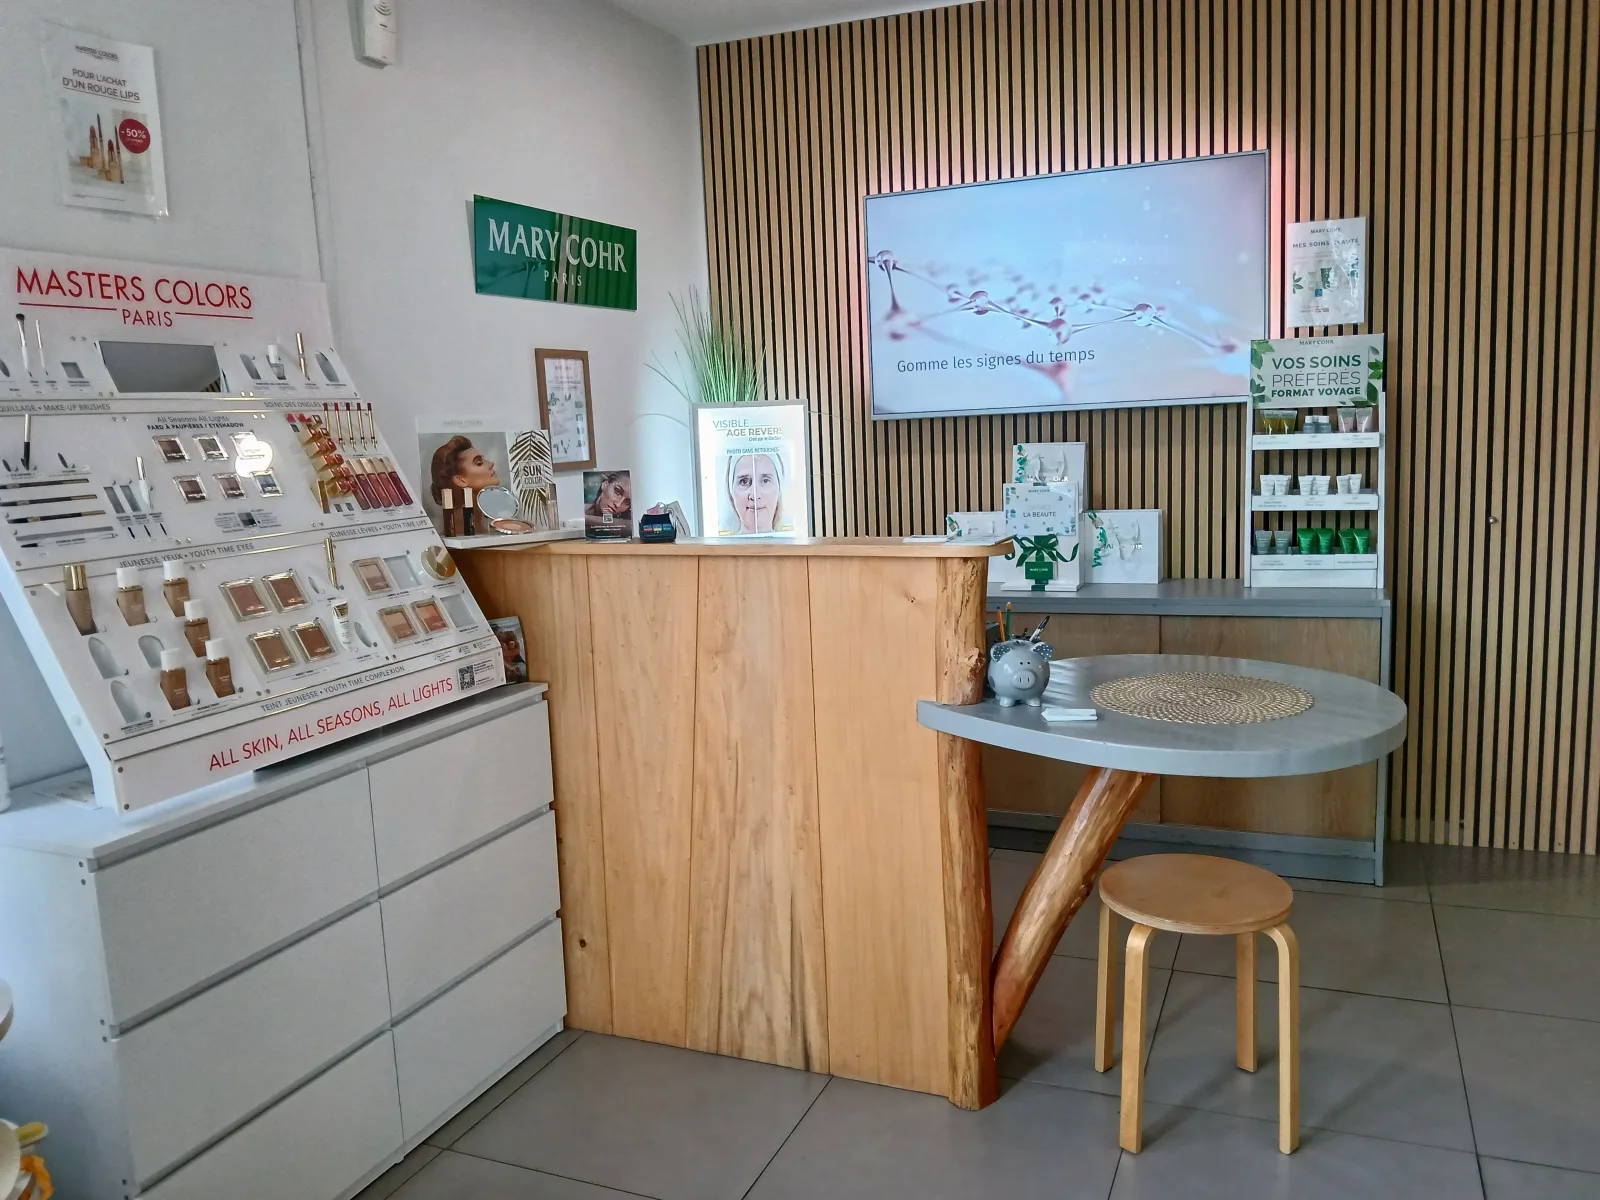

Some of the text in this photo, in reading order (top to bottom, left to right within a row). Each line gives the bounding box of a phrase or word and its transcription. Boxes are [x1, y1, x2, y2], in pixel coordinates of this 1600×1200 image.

[72, 68, 127, 87] POUR L'ACHAT
[62, 77, 140, 101] D'UN ROUGE LIPS
[488, 218, 627, 273] MARY COHR
[544, 270, 582, 286] PARIS
[16, 266, 252, 310] MASTERS COLORS
[122, 308, 173, 328] PARIS
[897, 349, 1095, 373] Gomme les signes du temps
[1272, 355, 1361, 370] VOS SOINS
[1272, 368, 1360, 387] PRÉFÉRÉS
[1272, 387, 1361, 397] FORMAT VOYAGE
[712, 419, 749, 428] VISIBLE
[726, 428, 746, 437] AGE
[523, 464, 542, 476] SUN
[329, 529, 357, 538] JEUNESSE
[120, 543, 254, 568] JEUNESSE YEUX YOUTH TIME EYES
[260, 666, 406, 712] TEINT JEUNESSE YOUTH TIME COMPLEXION
[210, 677, 453, 772] ALL SKIN, ALL SEASONS, ALL LIGHTS
